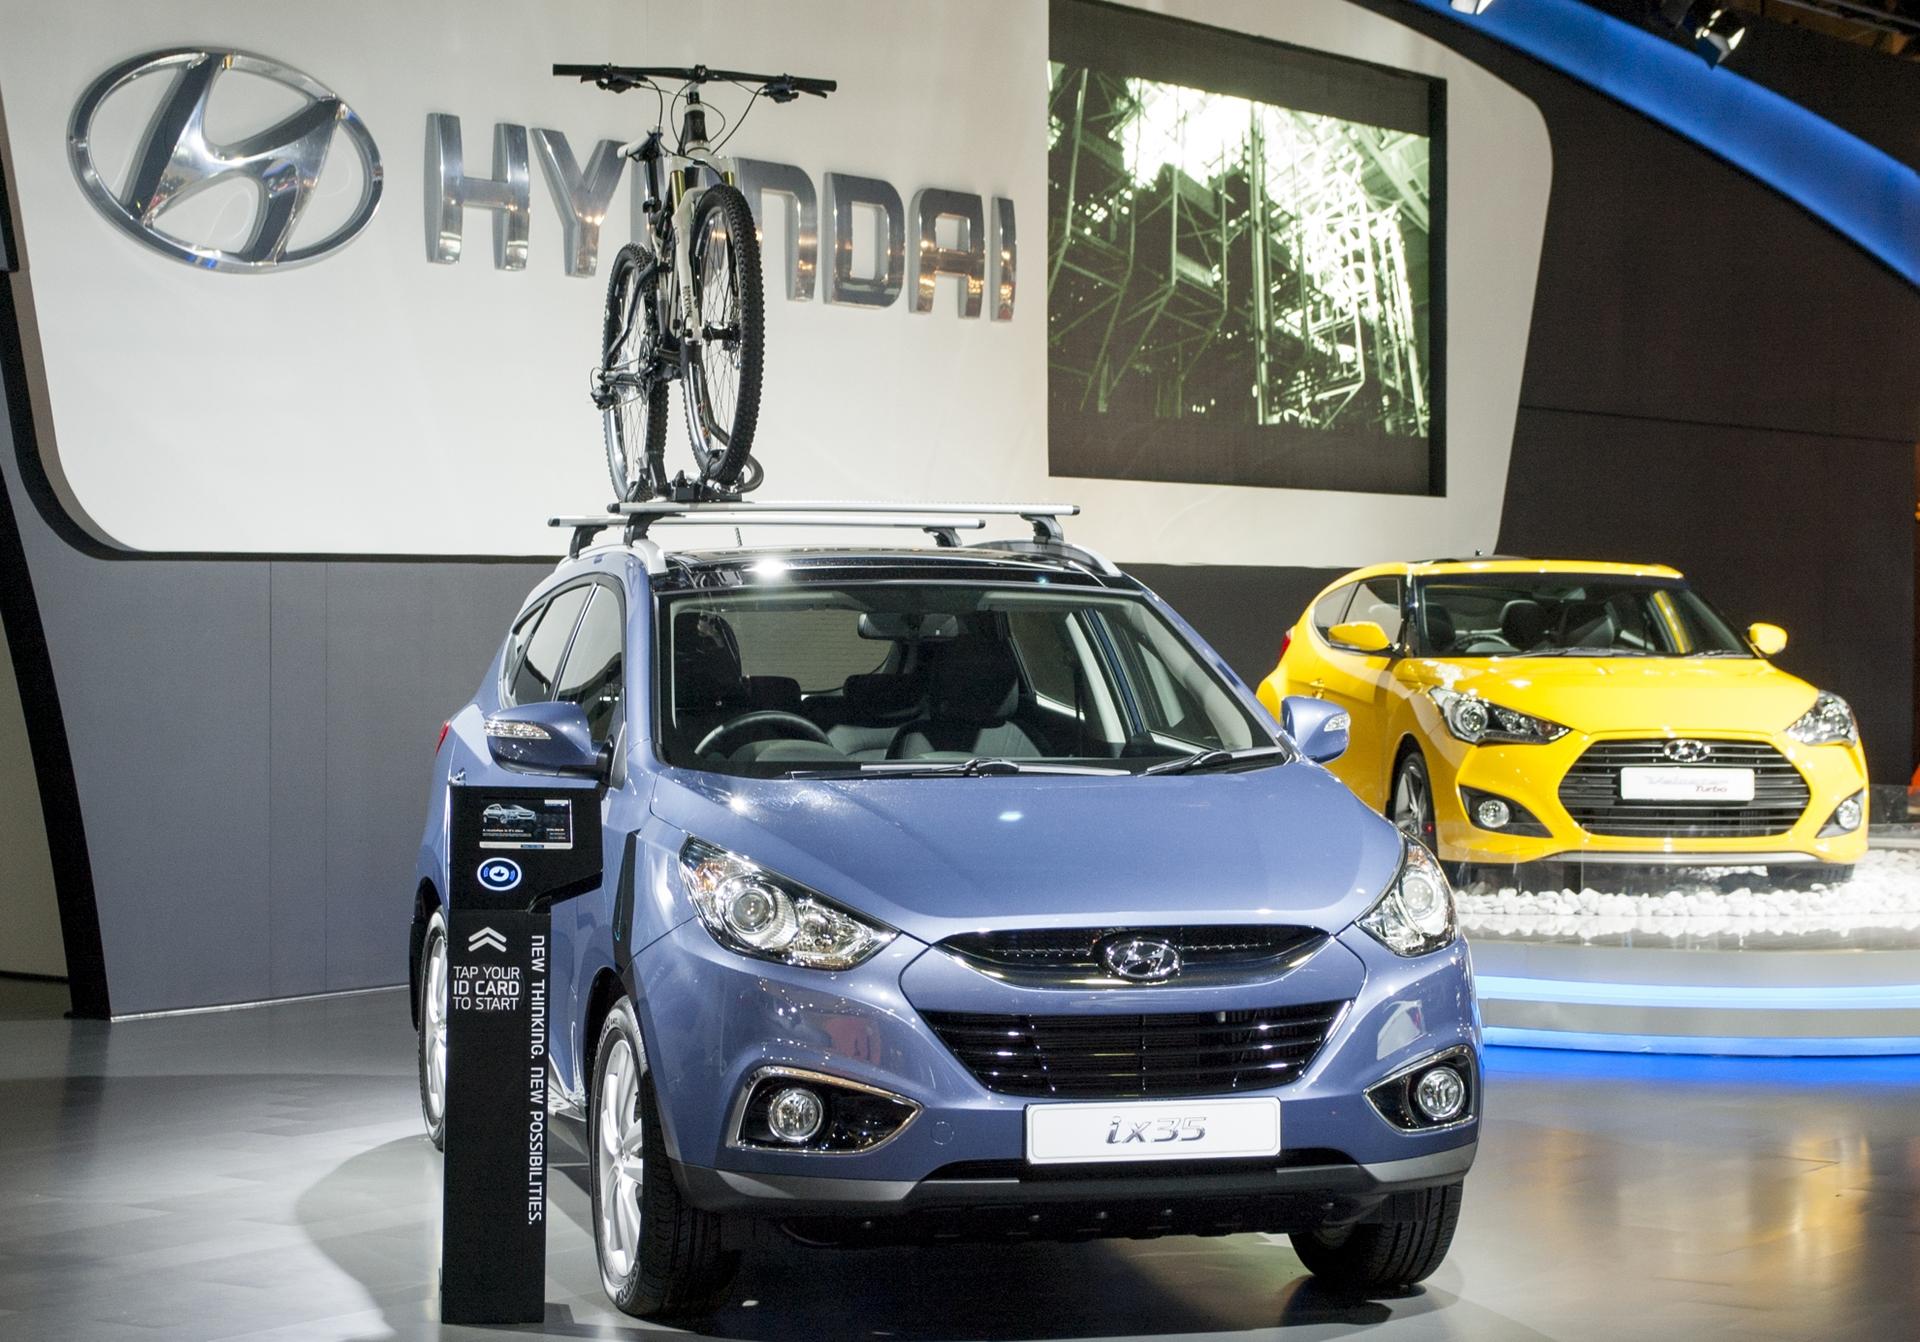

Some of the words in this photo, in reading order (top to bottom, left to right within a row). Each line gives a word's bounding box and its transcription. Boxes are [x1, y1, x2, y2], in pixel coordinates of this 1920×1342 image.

[531, 935, 545, 973] NEW
[453, 966, 478, 979] TAP
[483, 966, 520, 980] YOUR
[453, 980, 470, 995] ID
[475, 980, 520, 996] CARD
[452, 997, 472, 1010] TO
[475, 997, 520, 1011] START
[530, 979, 545, 1060] THINKING.
[530, 1067, 544, 1105] NEW
[1105, 1115, 1208, 1145] ix35
[528, 1111, 544, 1225] POSSIBILITIES.
